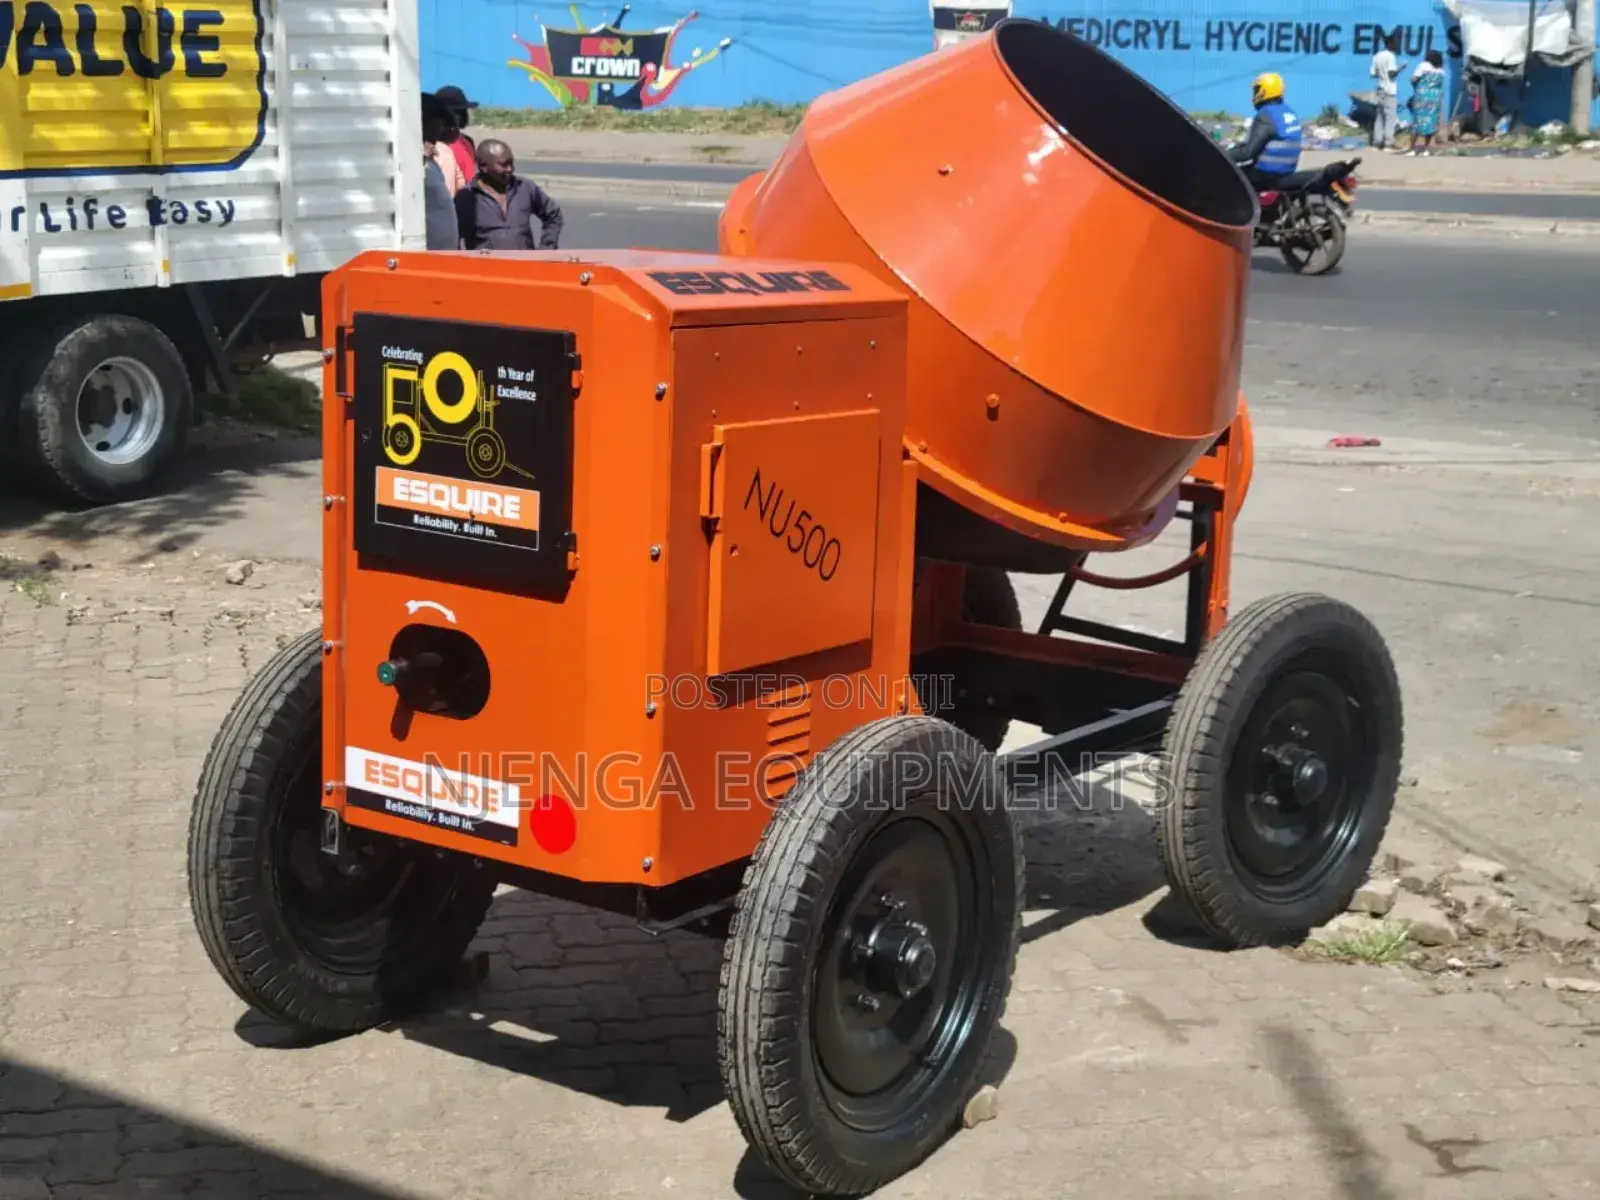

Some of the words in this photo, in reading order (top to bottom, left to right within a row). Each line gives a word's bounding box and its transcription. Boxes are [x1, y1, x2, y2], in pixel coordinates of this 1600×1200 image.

[1205, 21, 1342, 55] HYGIENIC
[571, 56, 641, 77] crown
[40, 196, 126, 232] Life
[645, 271, 852, 296] ESQUIRE
[381, 345, 424, 364] Celebrating
[497, 365, 507, 379] th
[508, 368, 525, 382] Year
[525, 369, 535, 382] of
[497, 384, 537, 401] Excellence
[393, 477, 521, 520] ESQUIRE
[413, 514, 461, 533] Reliability.
[463, 522, 484, 535] Built
[485, 525, 498, 538] In.
[744, 466, 841, 581] NU500
[364, 757, 499, 814] ESQUIRE
[385, 798, 436, 823] Reliability.
[438, 812, 460, 828] Built
